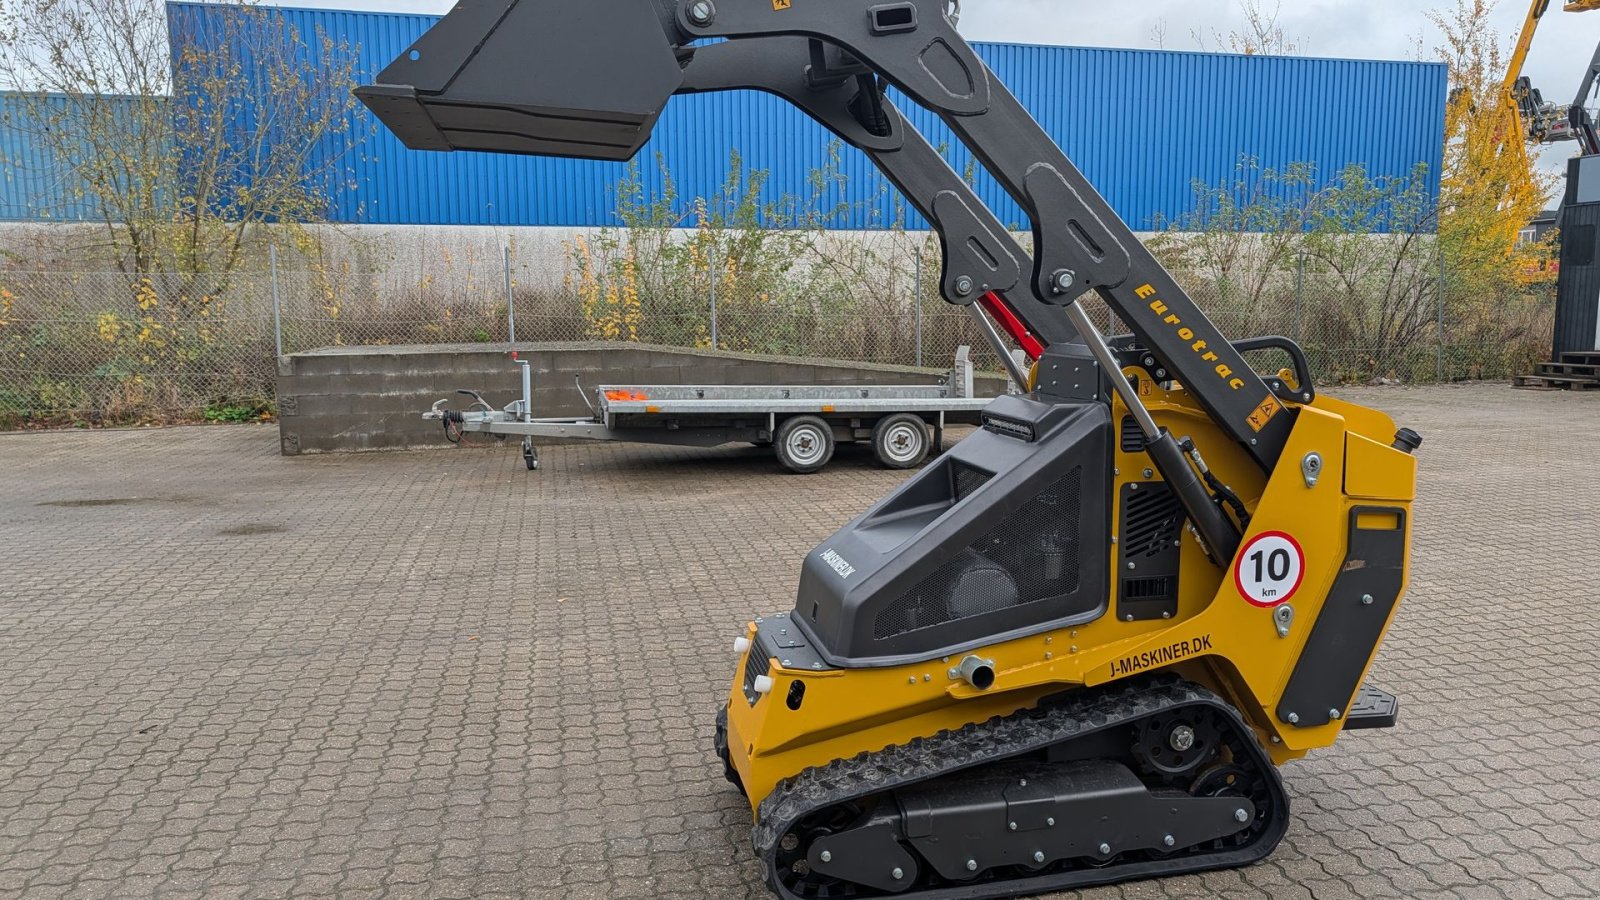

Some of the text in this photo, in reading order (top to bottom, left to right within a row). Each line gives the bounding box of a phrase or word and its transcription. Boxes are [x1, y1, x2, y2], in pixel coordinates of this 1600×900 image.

[1134, 283, 1245, 390] Eurotrac
[1250, 548, 1291, 583] 10
[1262, 587, 1277, 597] km
[1110, 633, 1213, 678] J-MASKINER.DK
